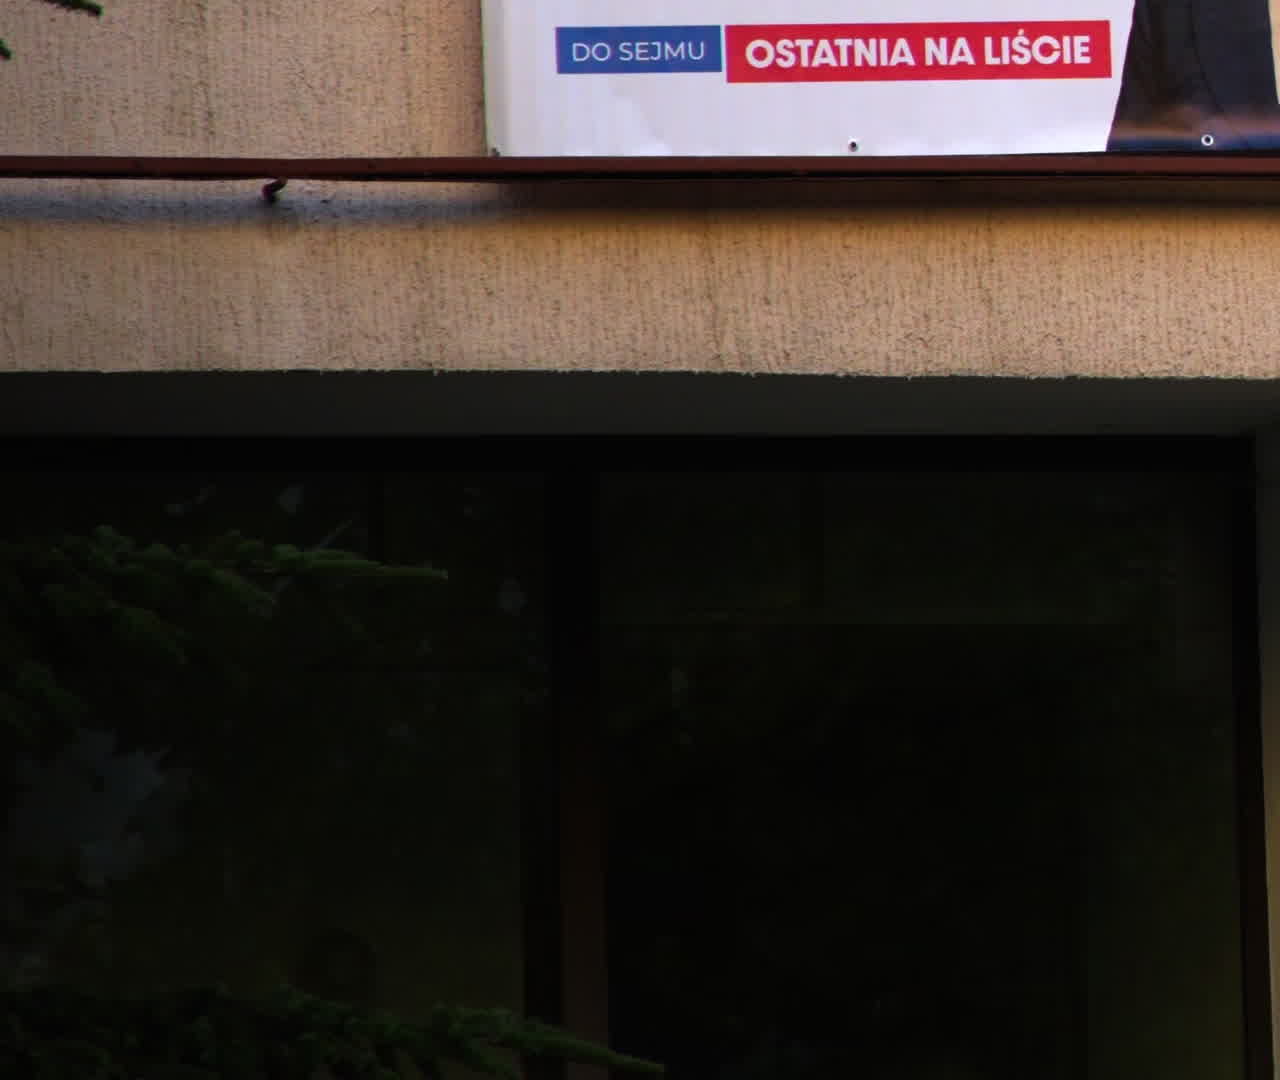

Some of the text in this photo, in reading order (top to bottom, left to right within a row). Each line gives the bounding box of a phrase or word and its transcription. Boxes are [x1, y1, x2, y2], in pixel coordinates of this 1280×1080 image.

[572, 41, 705, 62] DO SEJMU
[745, 28, 1092, 69] OSTATNIA NA LIŚCIE
